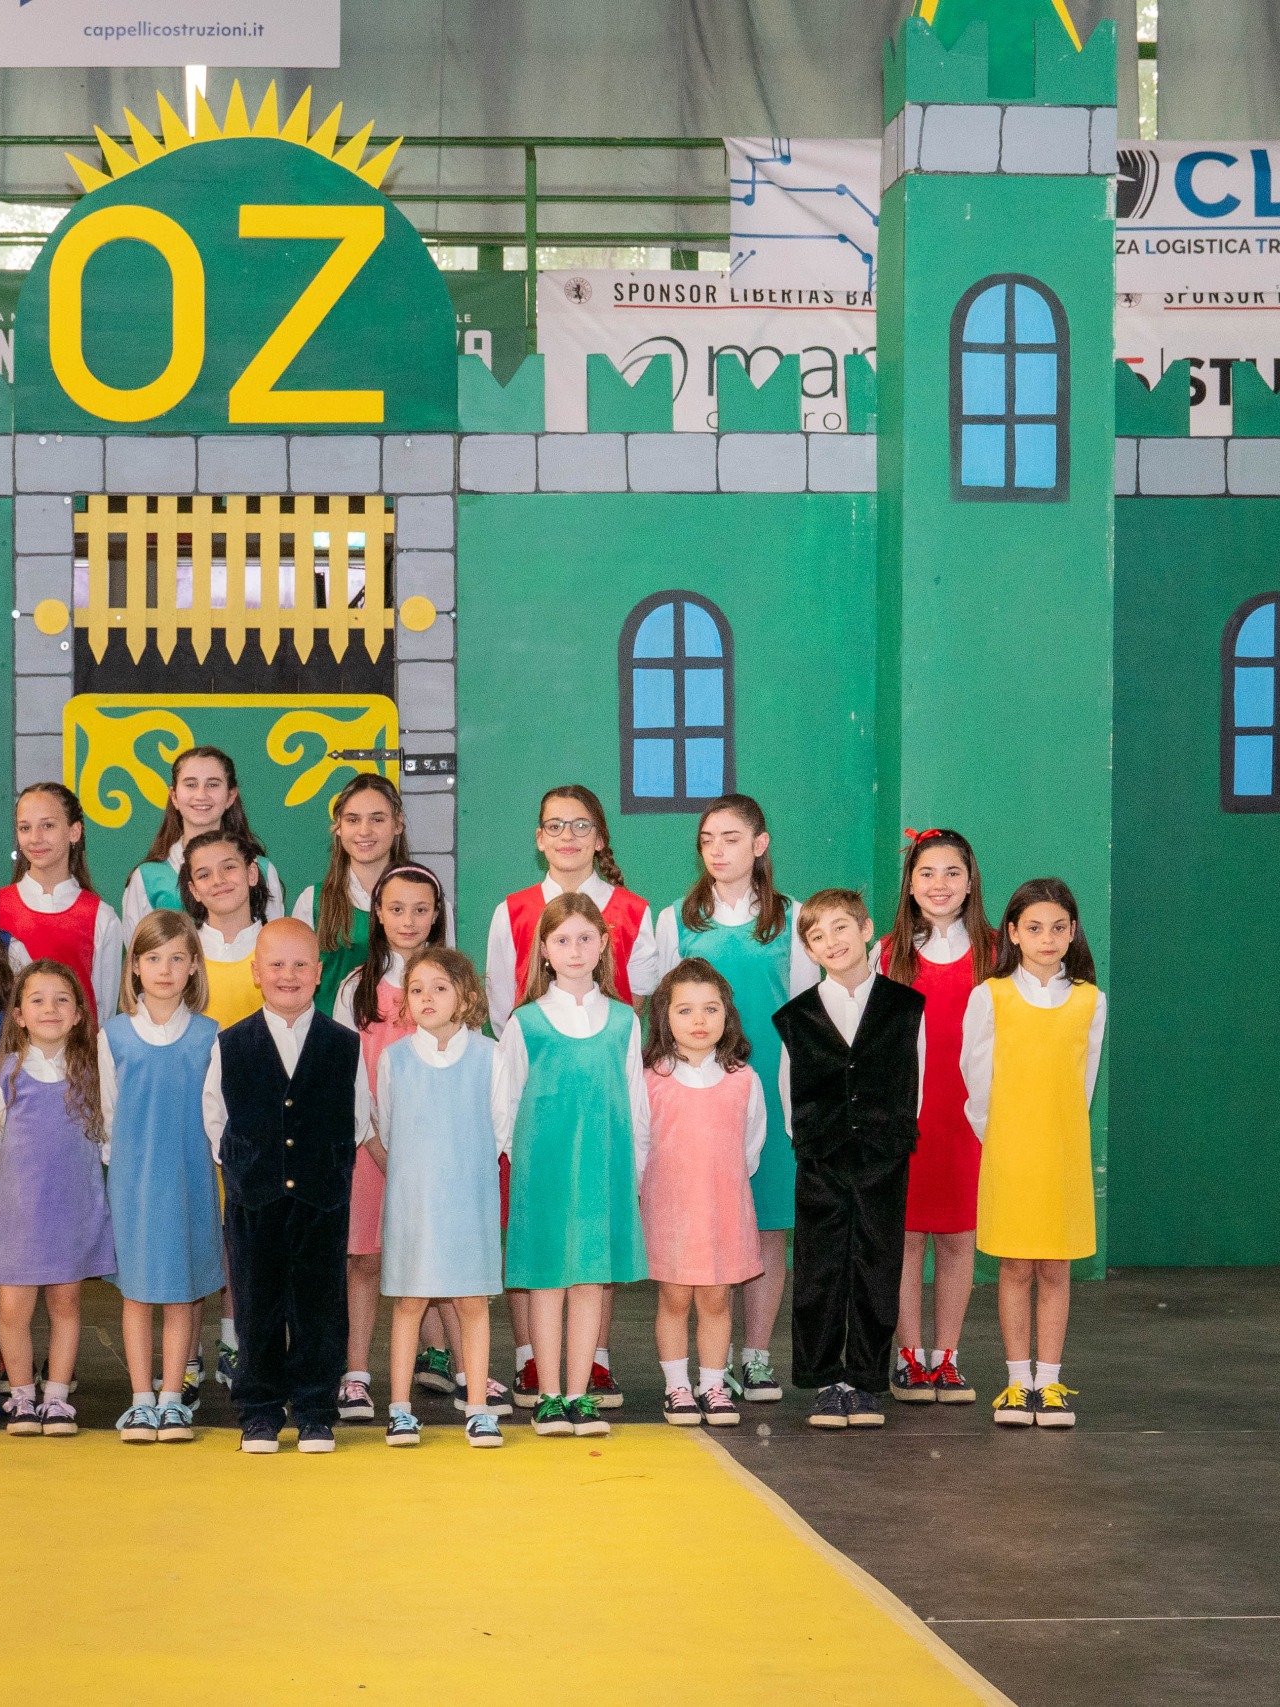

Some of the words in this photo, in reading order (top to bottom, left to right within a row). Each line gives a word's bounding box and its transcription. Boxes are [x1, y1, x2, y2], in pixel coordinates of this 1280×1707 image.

[83, 20, 265, 41] cappellicostruzioni.it
[1145, 239, 1251, 255] LOGISTICA
[613, 282, 718, 304] SPONSOR
[730, 287, 835, 306] LIBERTAS
[49, 204, 386, 424] OZ
